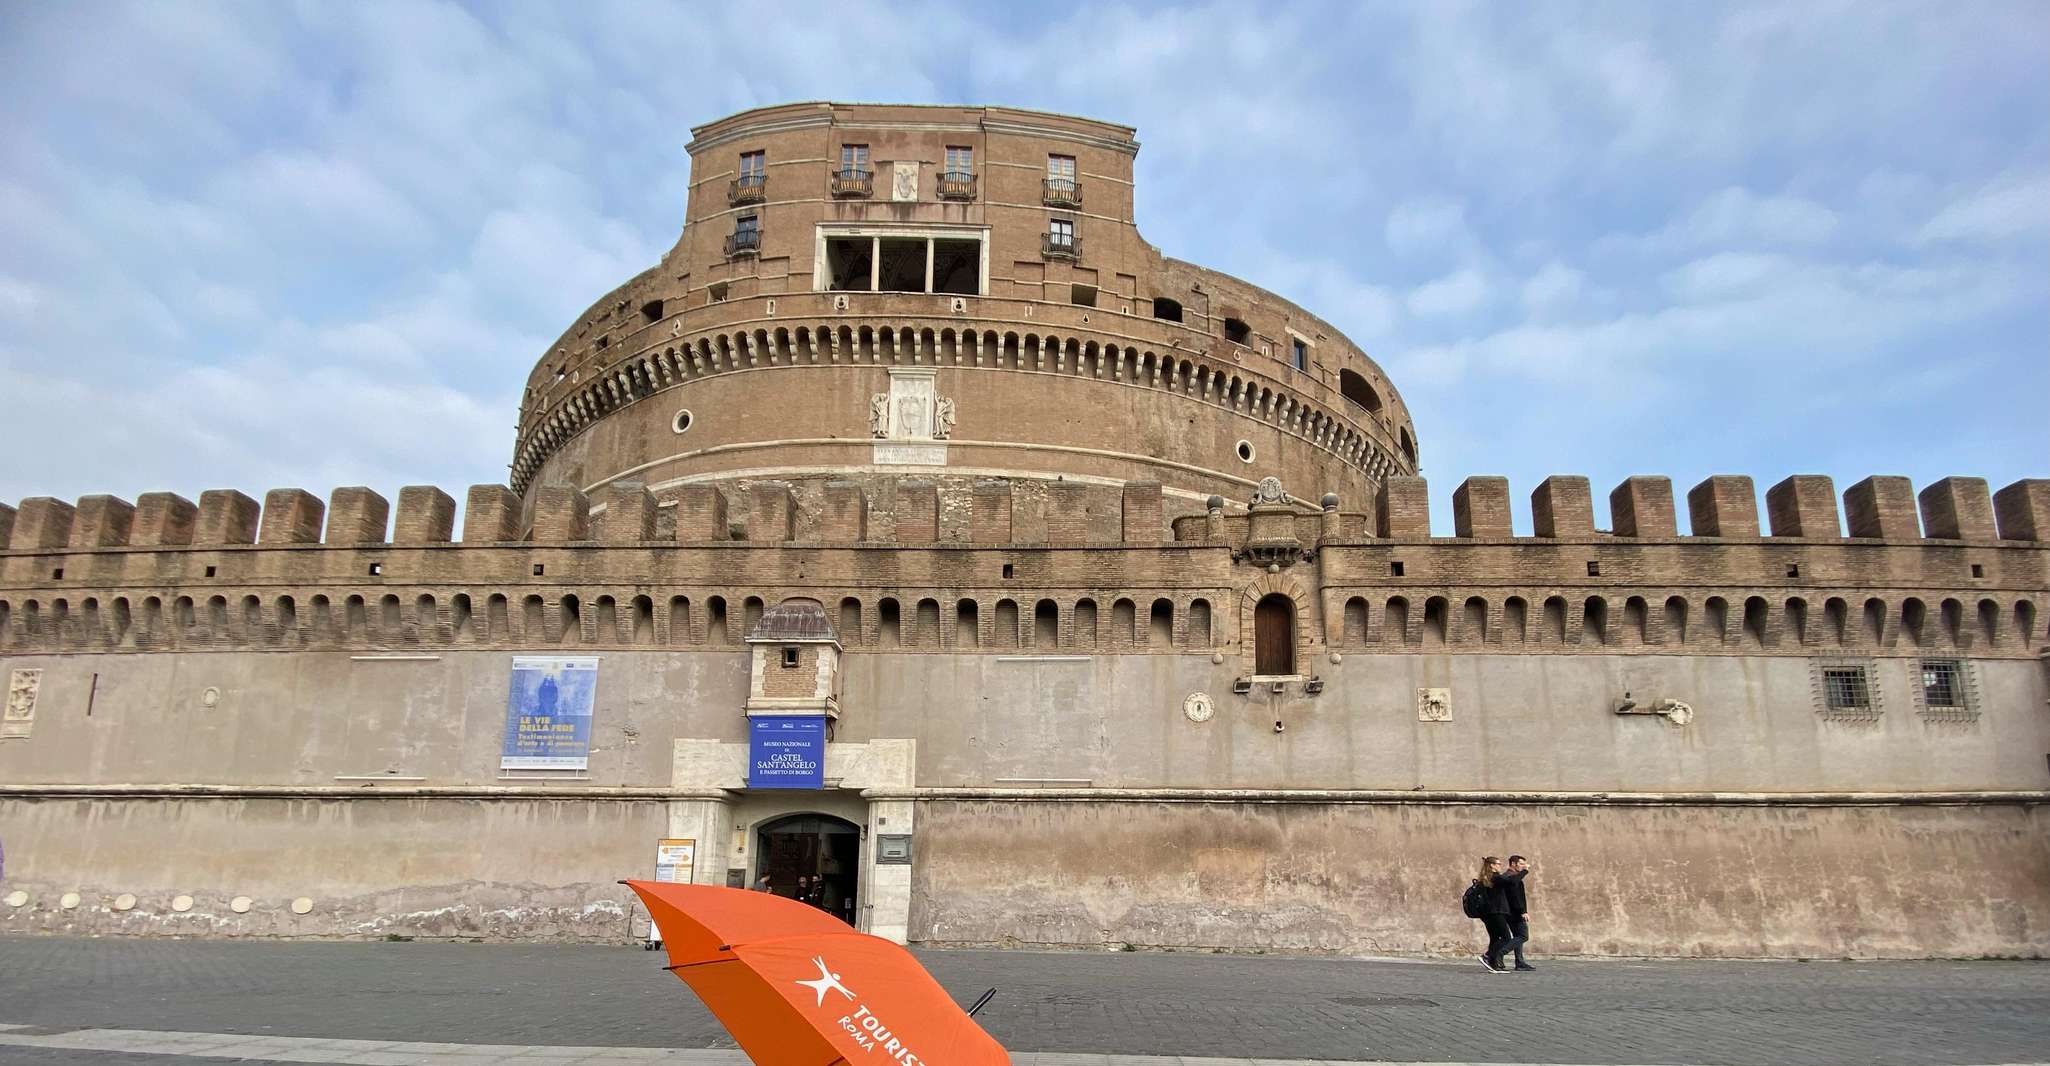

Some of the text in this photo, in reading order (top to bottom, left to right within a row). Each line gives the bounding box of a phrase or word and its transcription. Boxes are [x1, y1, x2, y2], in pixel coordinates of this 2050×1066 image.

[520, 716, 550, 724] LE VIE
[771, 753, 803, 761] CASTEL
[837, 1015, 875, 1053] ROMA
[853, 1004, 926, 1066] TOURIS
